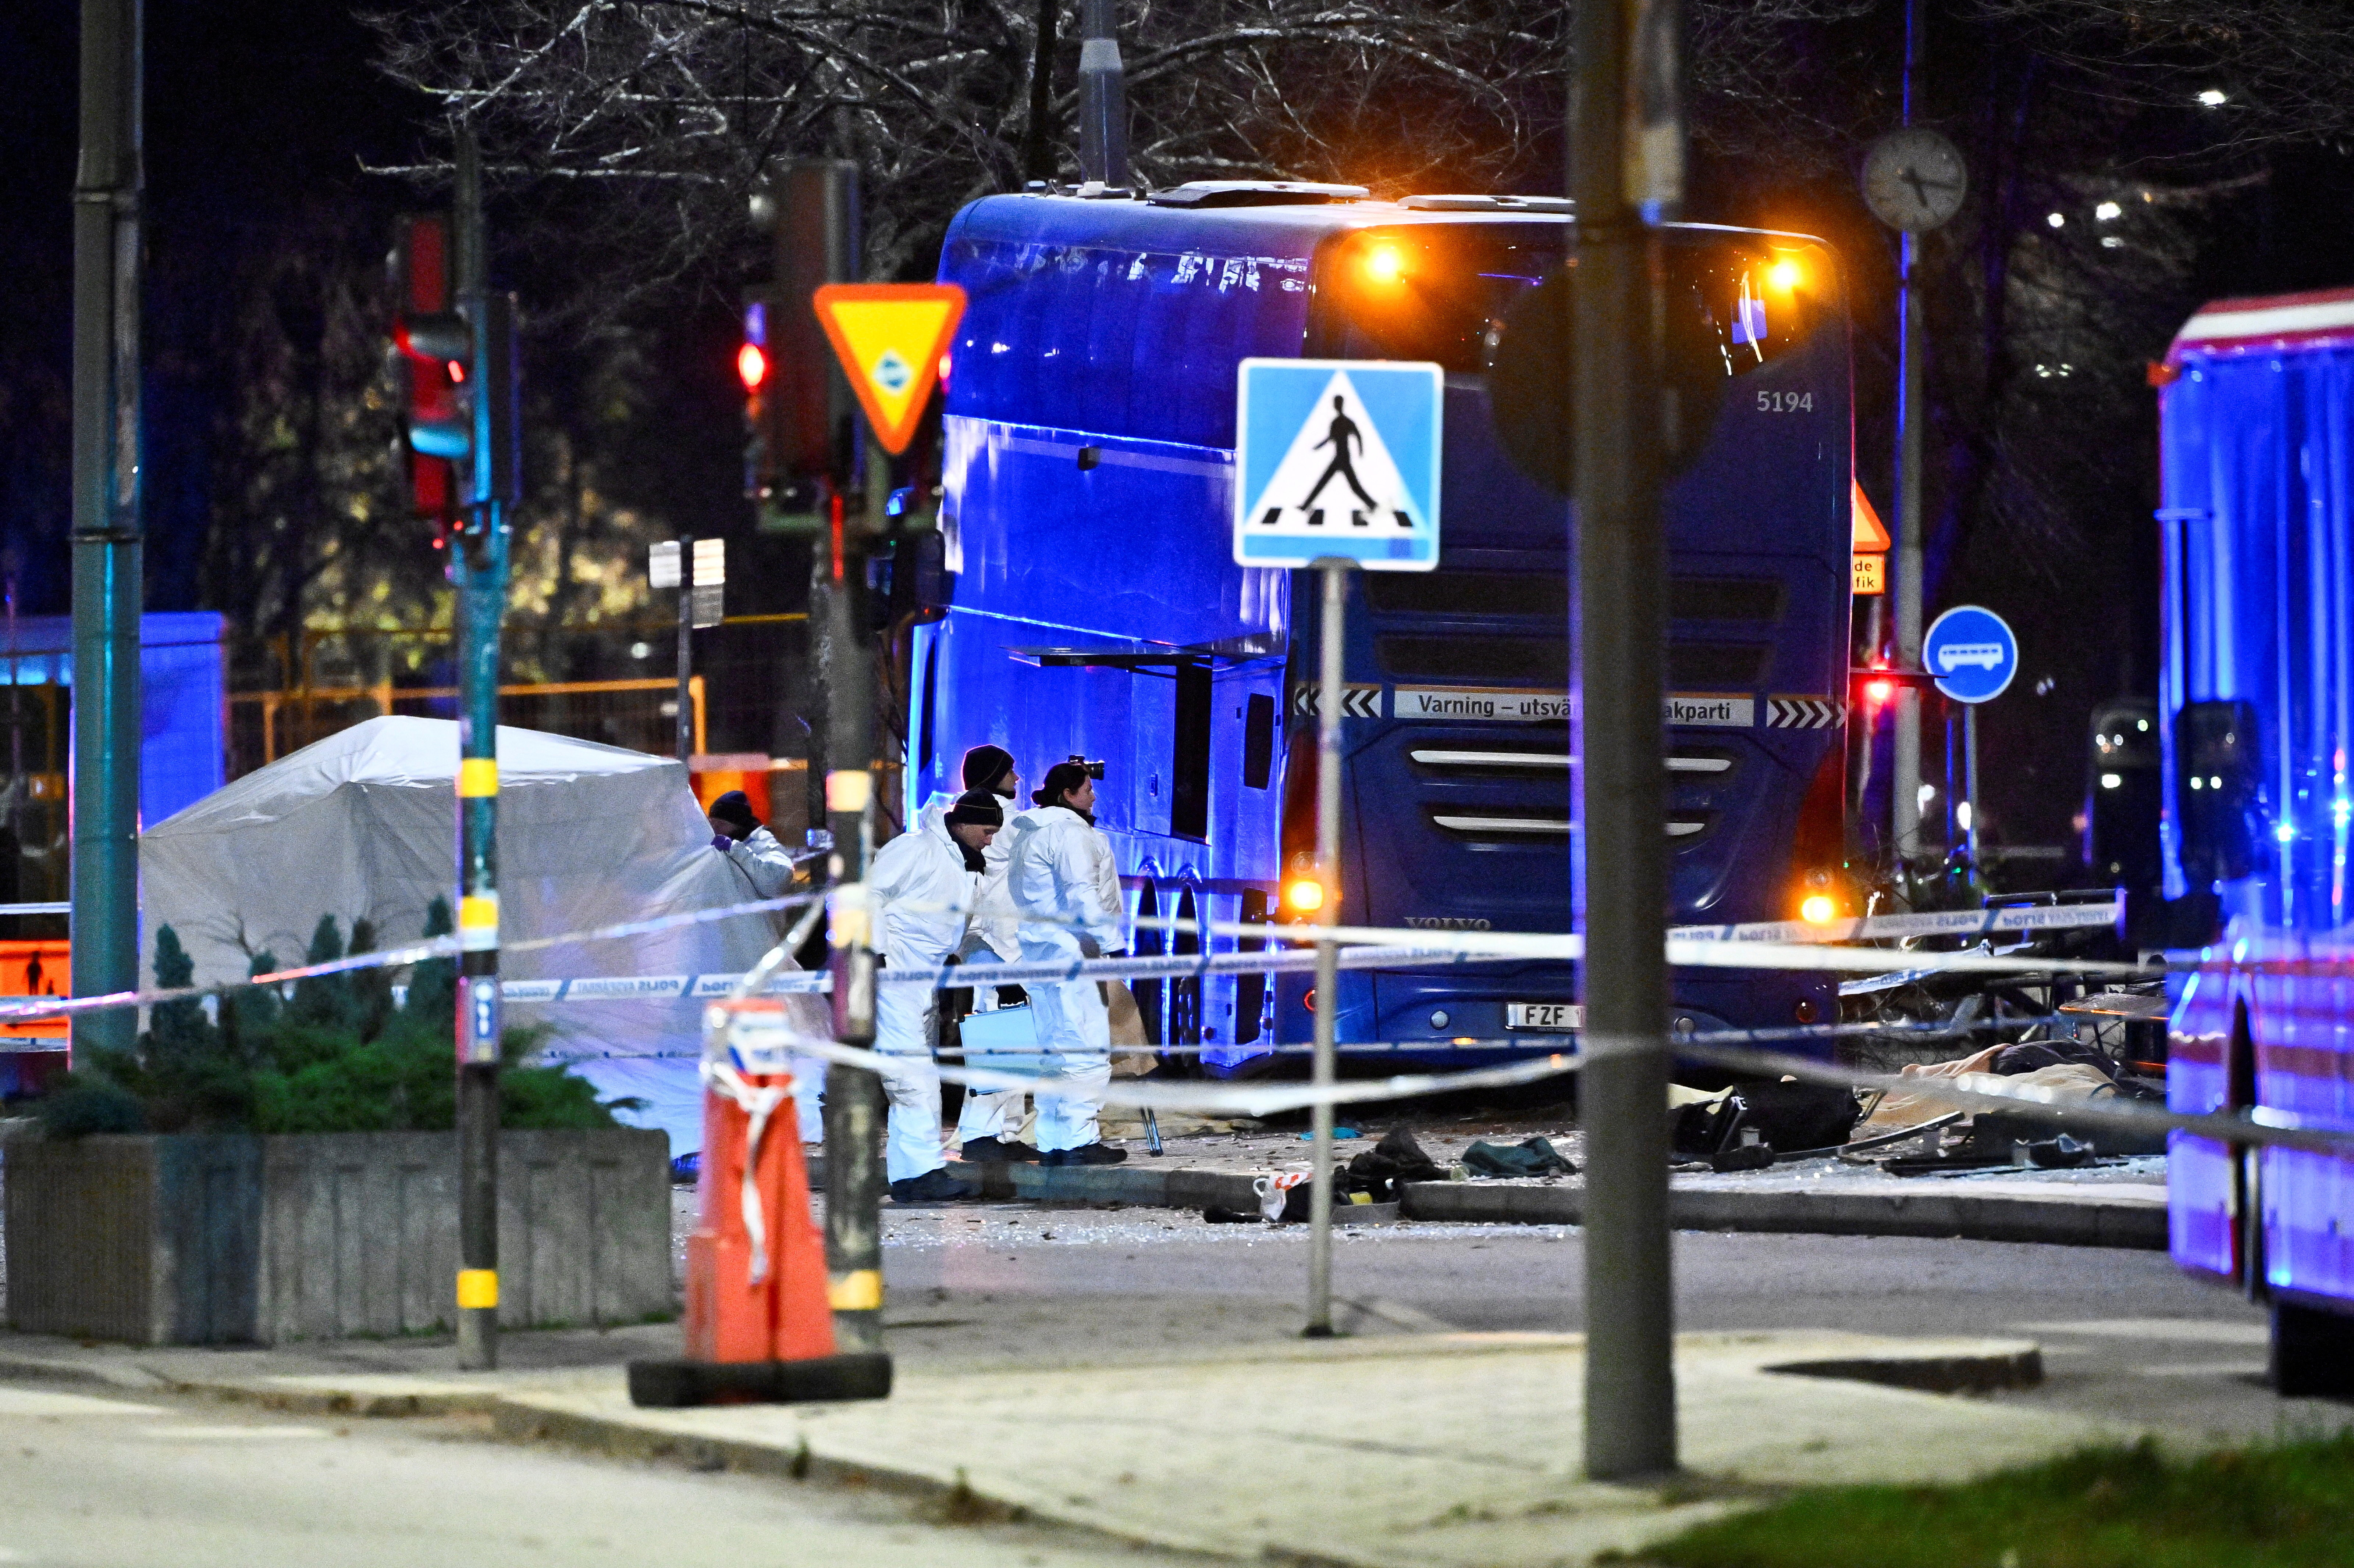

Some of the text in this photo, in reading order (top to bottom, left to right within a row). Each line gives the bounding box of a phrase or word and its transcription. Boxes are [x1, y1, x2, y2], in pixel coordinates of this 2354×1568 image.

[1757, 391, 1813, 412] 5194
[1854, 560, 1872, 571] de
[1856, 577, 1875, 588] fik
[1419, 695, 1494, 717] Varning
[1520, 698, 1571, 716] utsvä
[1664, 701, 1731, 722] akparti
[1404, 917, 1490, 930] VOLVO
[1526, 1006, 1565, 1025] FZF
